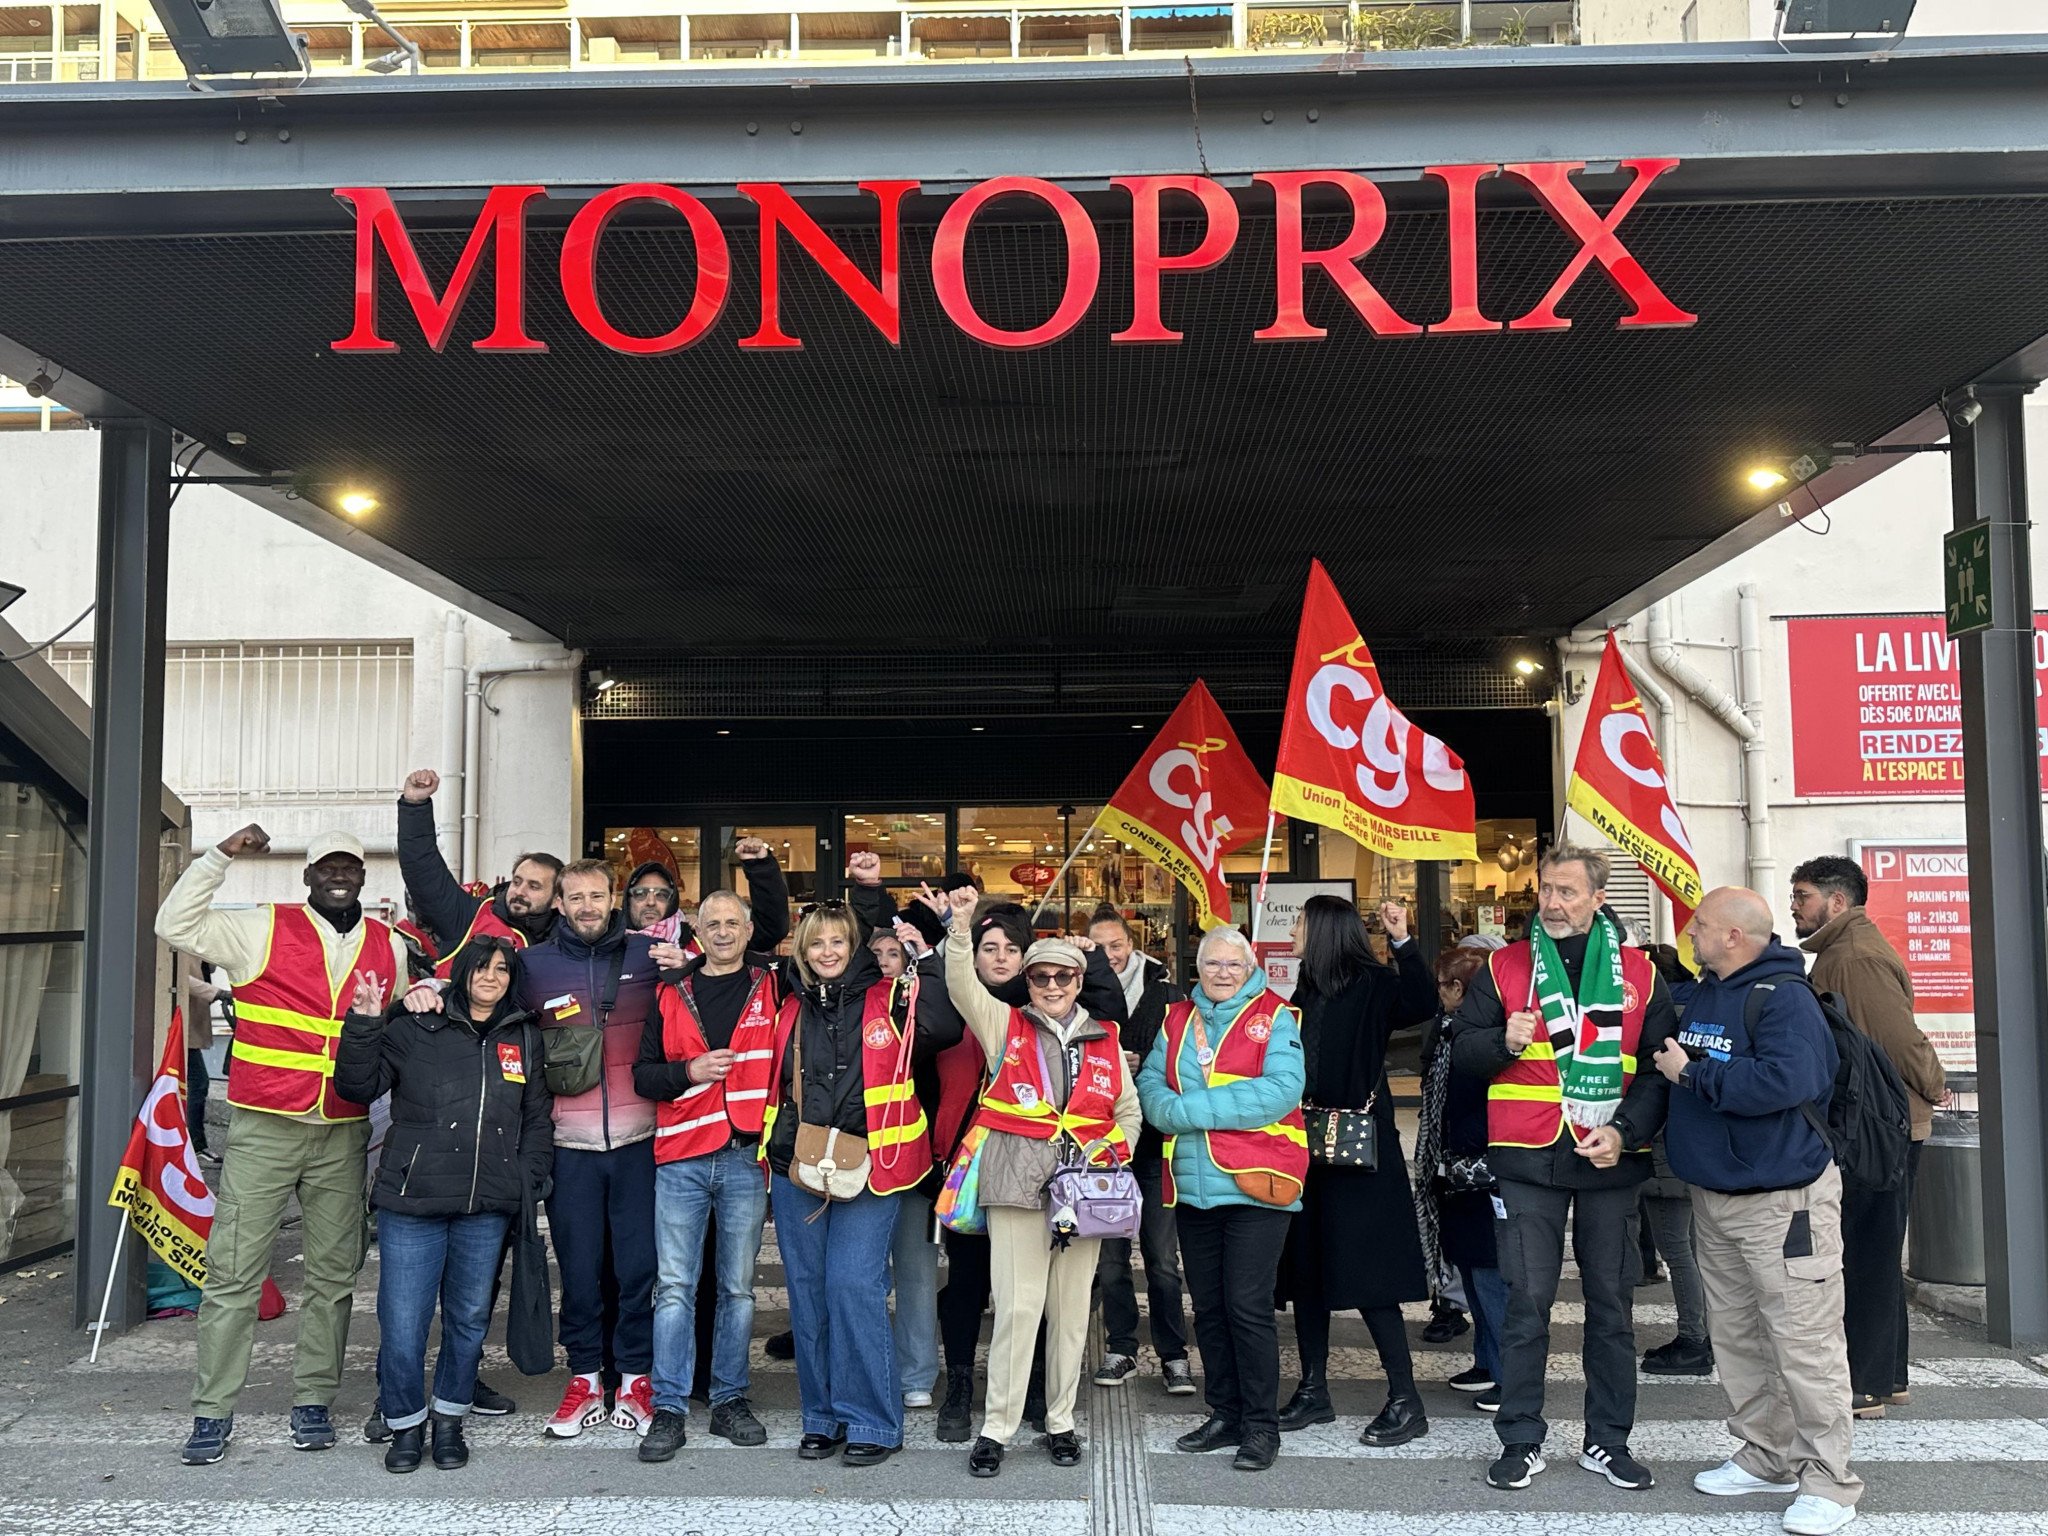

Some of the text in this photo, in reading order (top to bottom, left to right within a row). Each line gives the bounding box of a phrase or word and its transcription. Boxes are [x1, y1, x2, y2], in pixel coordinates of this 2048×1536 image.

[331, 159, 1697, 354] MONOPRIX
[1855, 632, 1898, 673] LA
[1917, 684, 1949, 701] AVEC
[1860, 703, 1885, 724] DÈS
[1886, 706, 1913, 724] 50€
[1863, 758, 1964, 782] À L'ESPACE L
[1302, 786, 1341, 809] Union
[1370, 818, 1442, 843] MARSEILLE
[1120, 822, 1172, 860] CONSEIL
[1371, 831, 1394, 851] Ville
[1622, 824, 1663, 858] Union
[1592, 807, 1696, 901] MARSEILLE
[1159, 856, 1186, 881] PACA
[1875, 850, 1896, 879] P
[1266, 901, 1295, 912] Cette
[1907, 891, 1948, 903] PARKING
[1266, 915, 1288, 926] chez
[1907, 911, 1921, 924] 8H
[1929, 911, 1959, 924] 21H30
[1908, 925, 1917, 934] DU
[1918, 925, 1937, 934] LUNDI
[1938, 925, 1947, 934] AU
[1908, 939, 1922, 951] 8H
[1930, 939, 1951, 951] 20H
[1909, 953, 1951, 961] LE DIMANCHE
[1611, 953, 1623, 987] SEA
[1677, 1031, 1733, 1053] BLUE STARS
[1946, 1031, 1964, 1039] VOUS
[501, 1060, 523, 1074] cgt
[1093, 1073, 1111, 1090] cgt
[1580, 1075, 1610, 1085] FREE
[1566, 1085, 1621, 1096] PALESTINE
[123, 1178, 208, 1269] Uon Locale
[115, 1189, 207, 1281] Meille Sud
